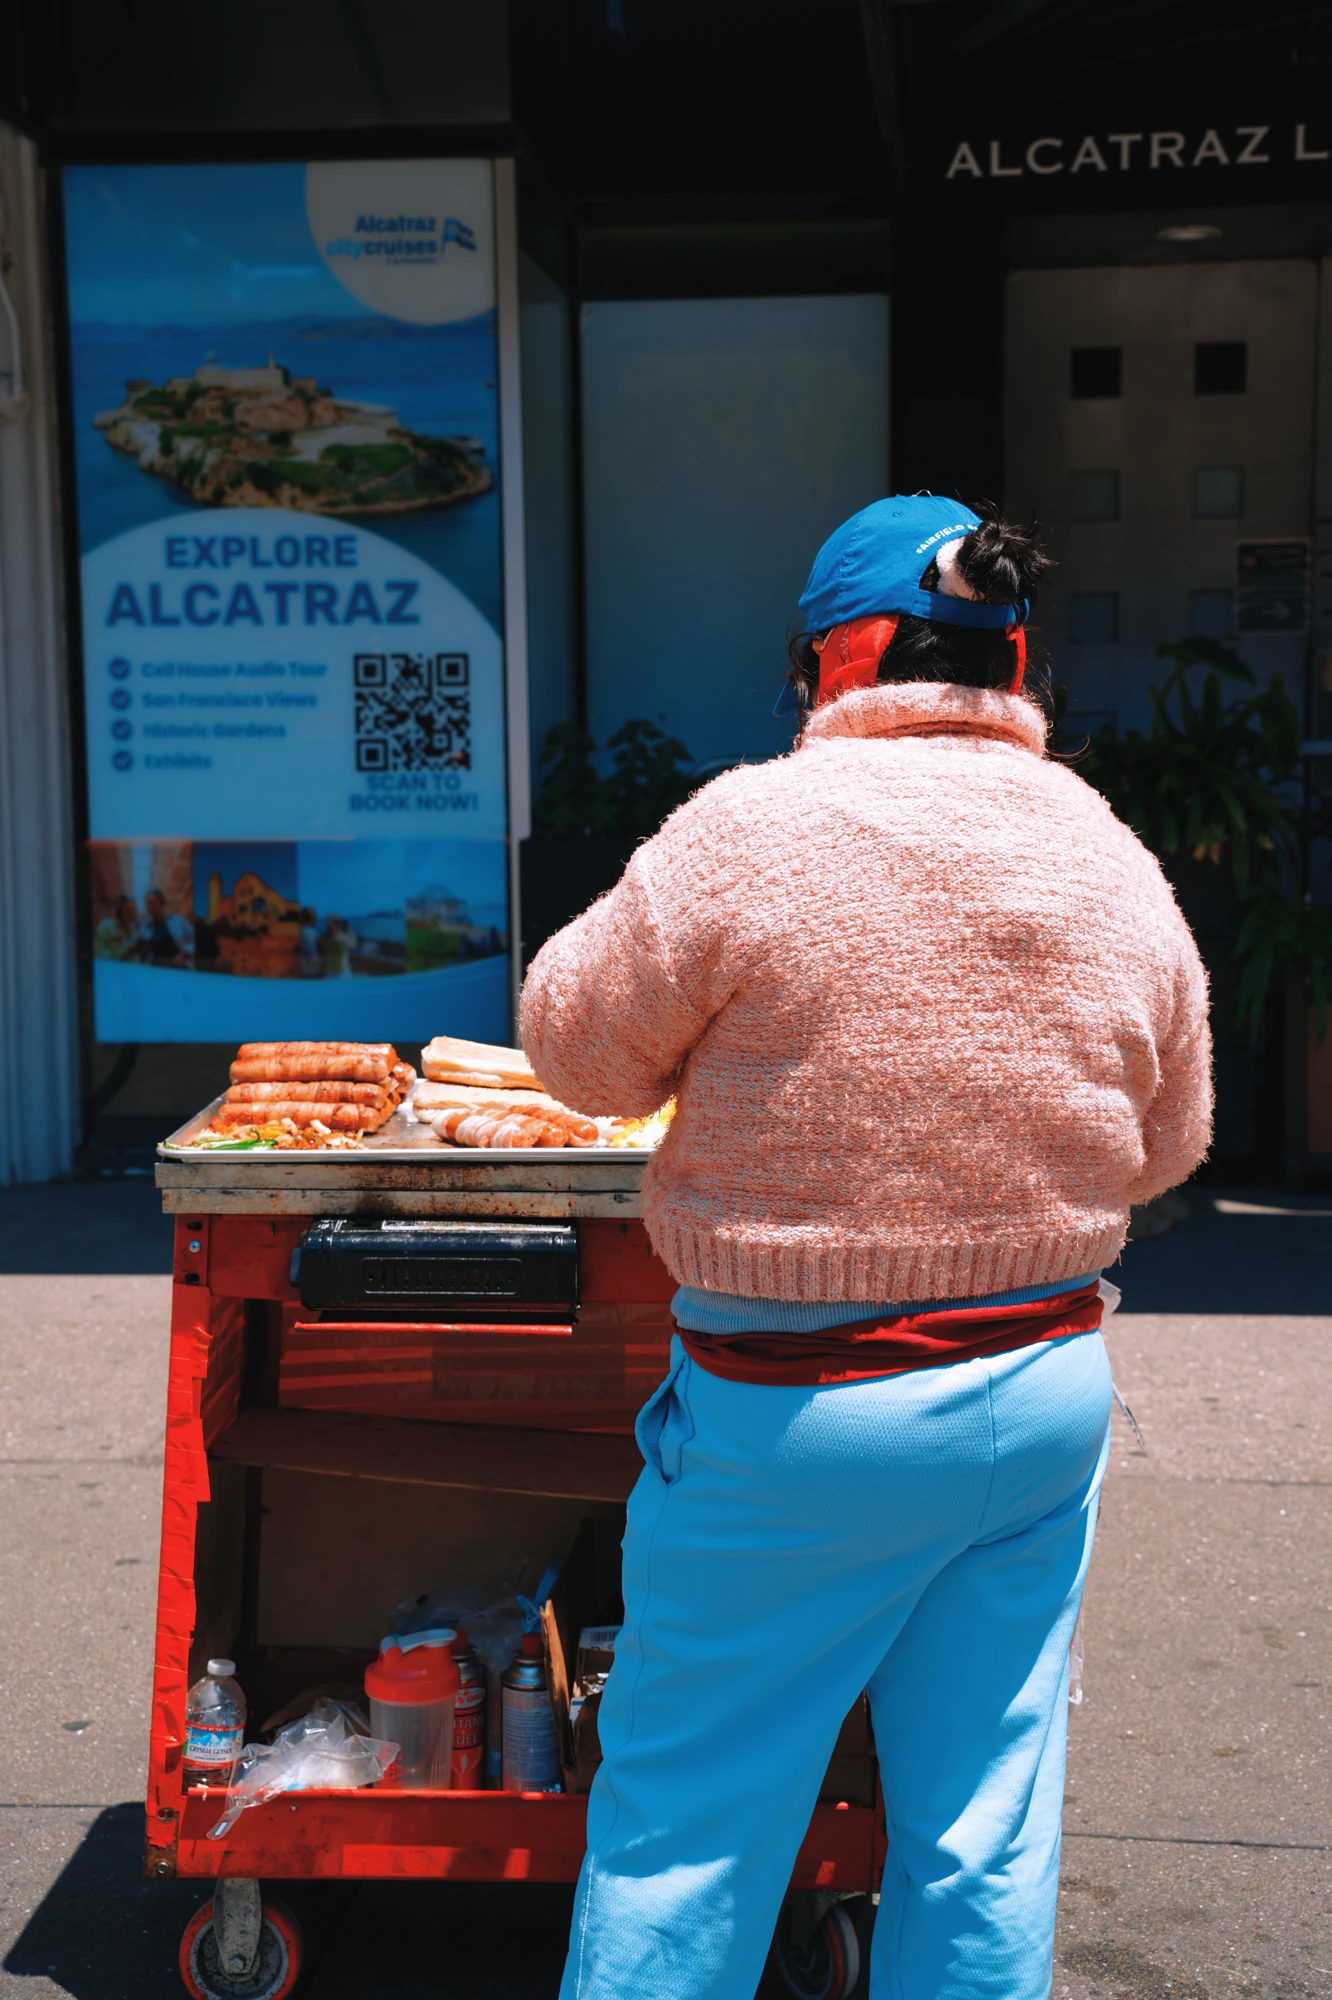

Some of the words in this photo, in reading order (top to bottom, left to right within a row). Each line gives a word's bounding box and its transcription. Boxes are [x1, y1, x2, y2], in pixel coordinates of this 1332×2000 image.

[946, 125, 1271, 179] ALCATRAZ
[355, 214, 436, 233] Alcatraz
[326, 237, 438, 260] citycruises
[916, 524, 965, 554] FAIRFIELD
[166, 535, 358, 568] EXPLORE
[107, 580, 421, 627] ALCATRAZ
[177, 662, 232, 678] House
[234, 661, 286, 678] Audio
[288, 661, 328, 677] Tour
[265, 691, 318, 708] Views
[142, 722, 209, 738] Historic
[213, 723, 287, 738] Gardens
[366, 773, 427, 791] SCAN
[433, 773, 461, 791] TO
[350, 794, 410, 812] BOOK
[416, 793, 479, 812] NOW!
